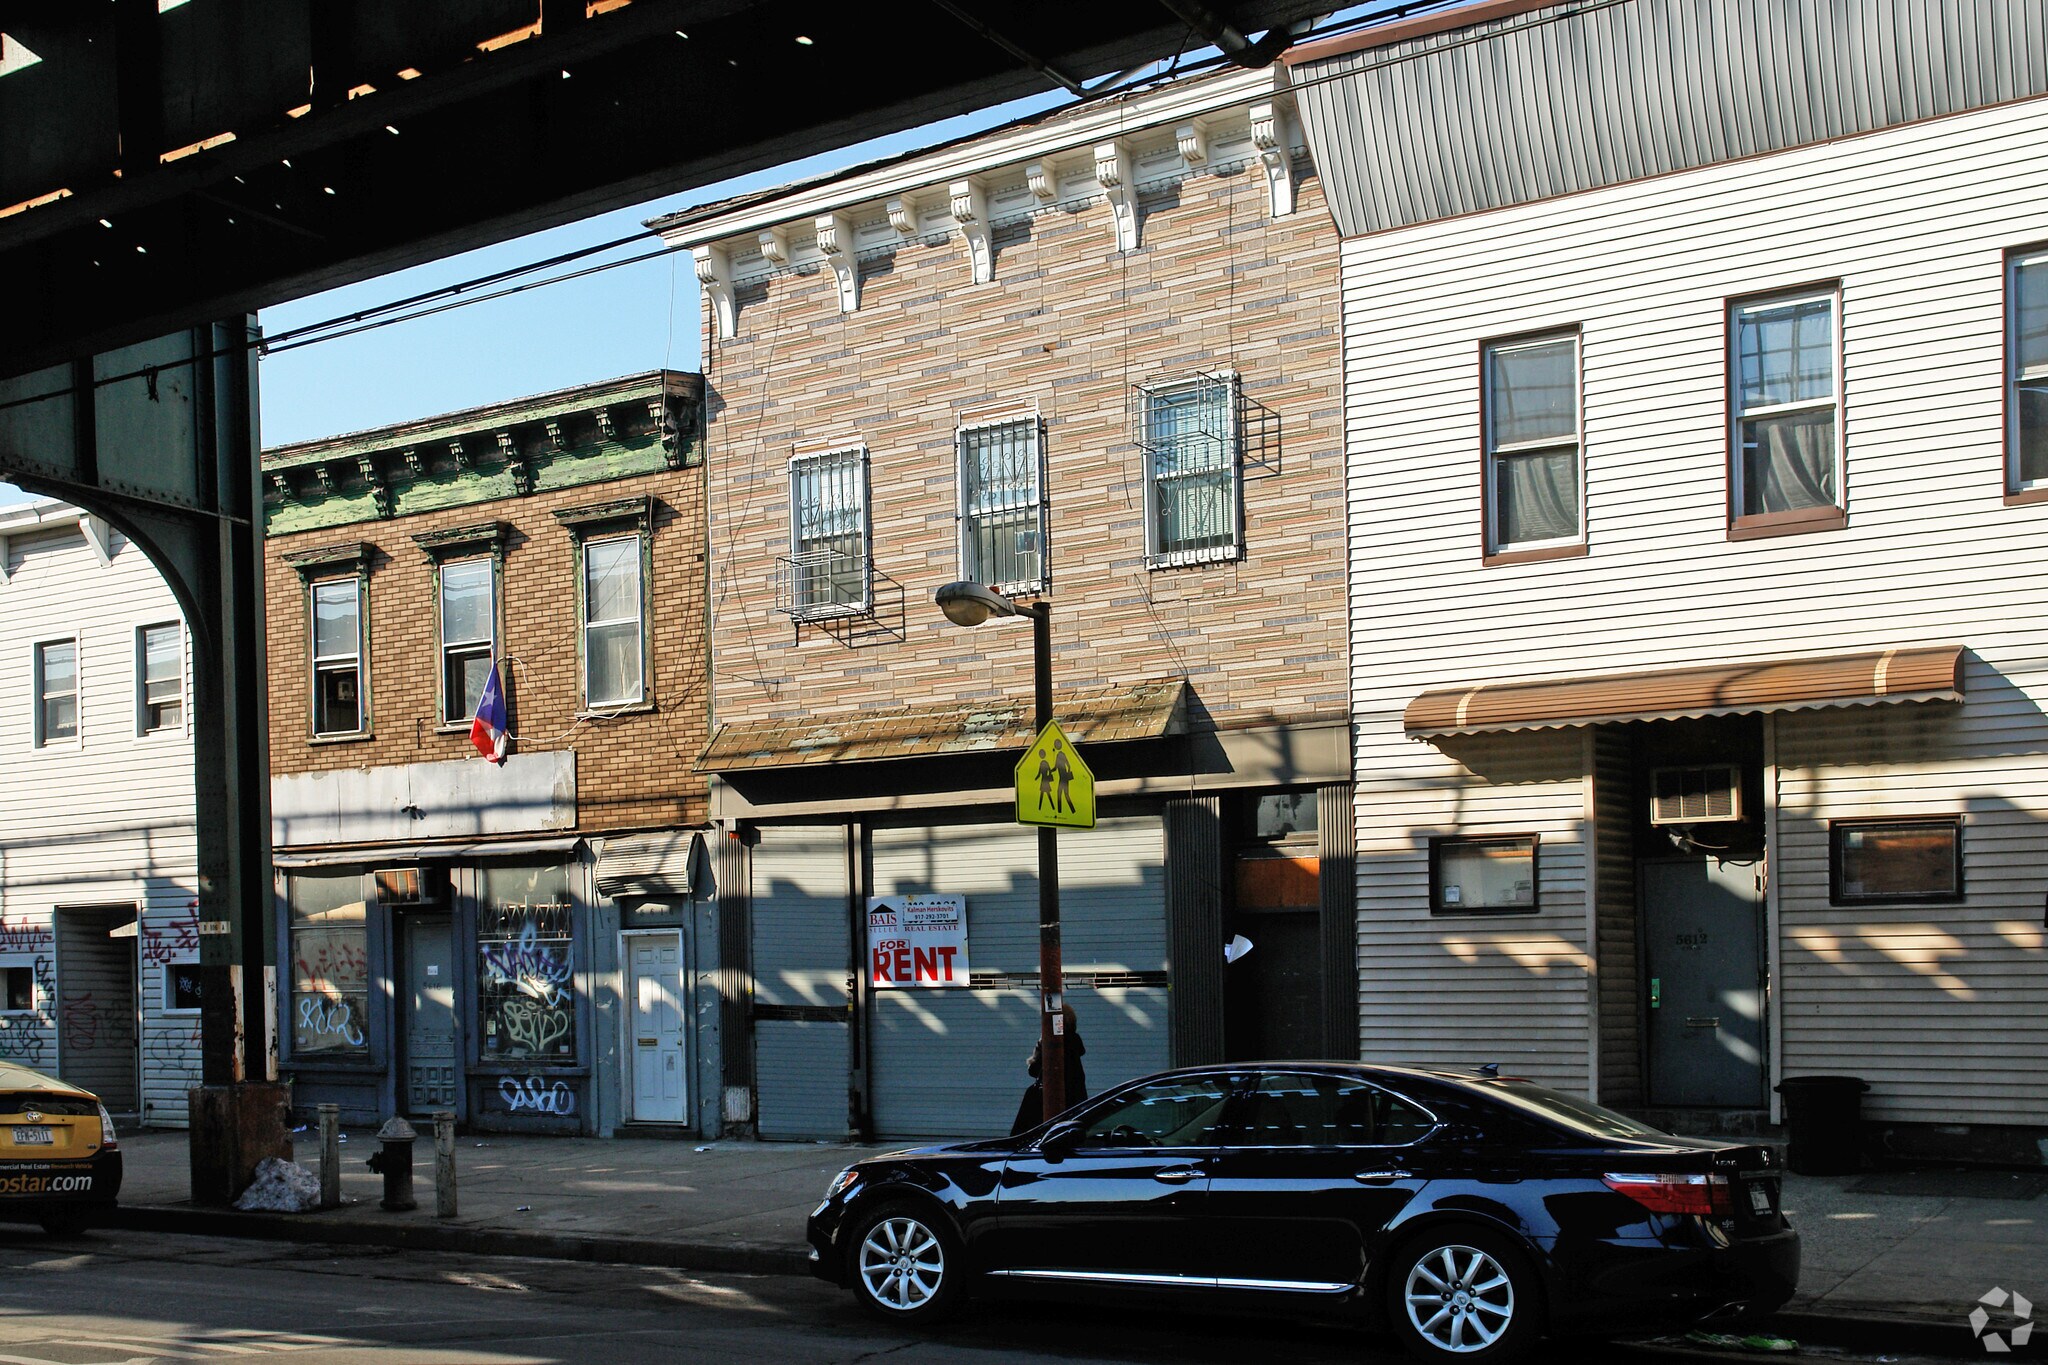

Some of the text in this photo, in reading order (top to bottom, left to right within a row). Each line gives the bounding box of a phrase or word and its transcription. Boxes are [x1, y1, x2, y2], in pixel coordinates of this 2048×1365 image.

[870, 914, 897, 925] BAIS
[1676, 933, 1707, 945] 5612
[880, 940, 906, 952] FOR
[873, 946, 957, 981] RENT
